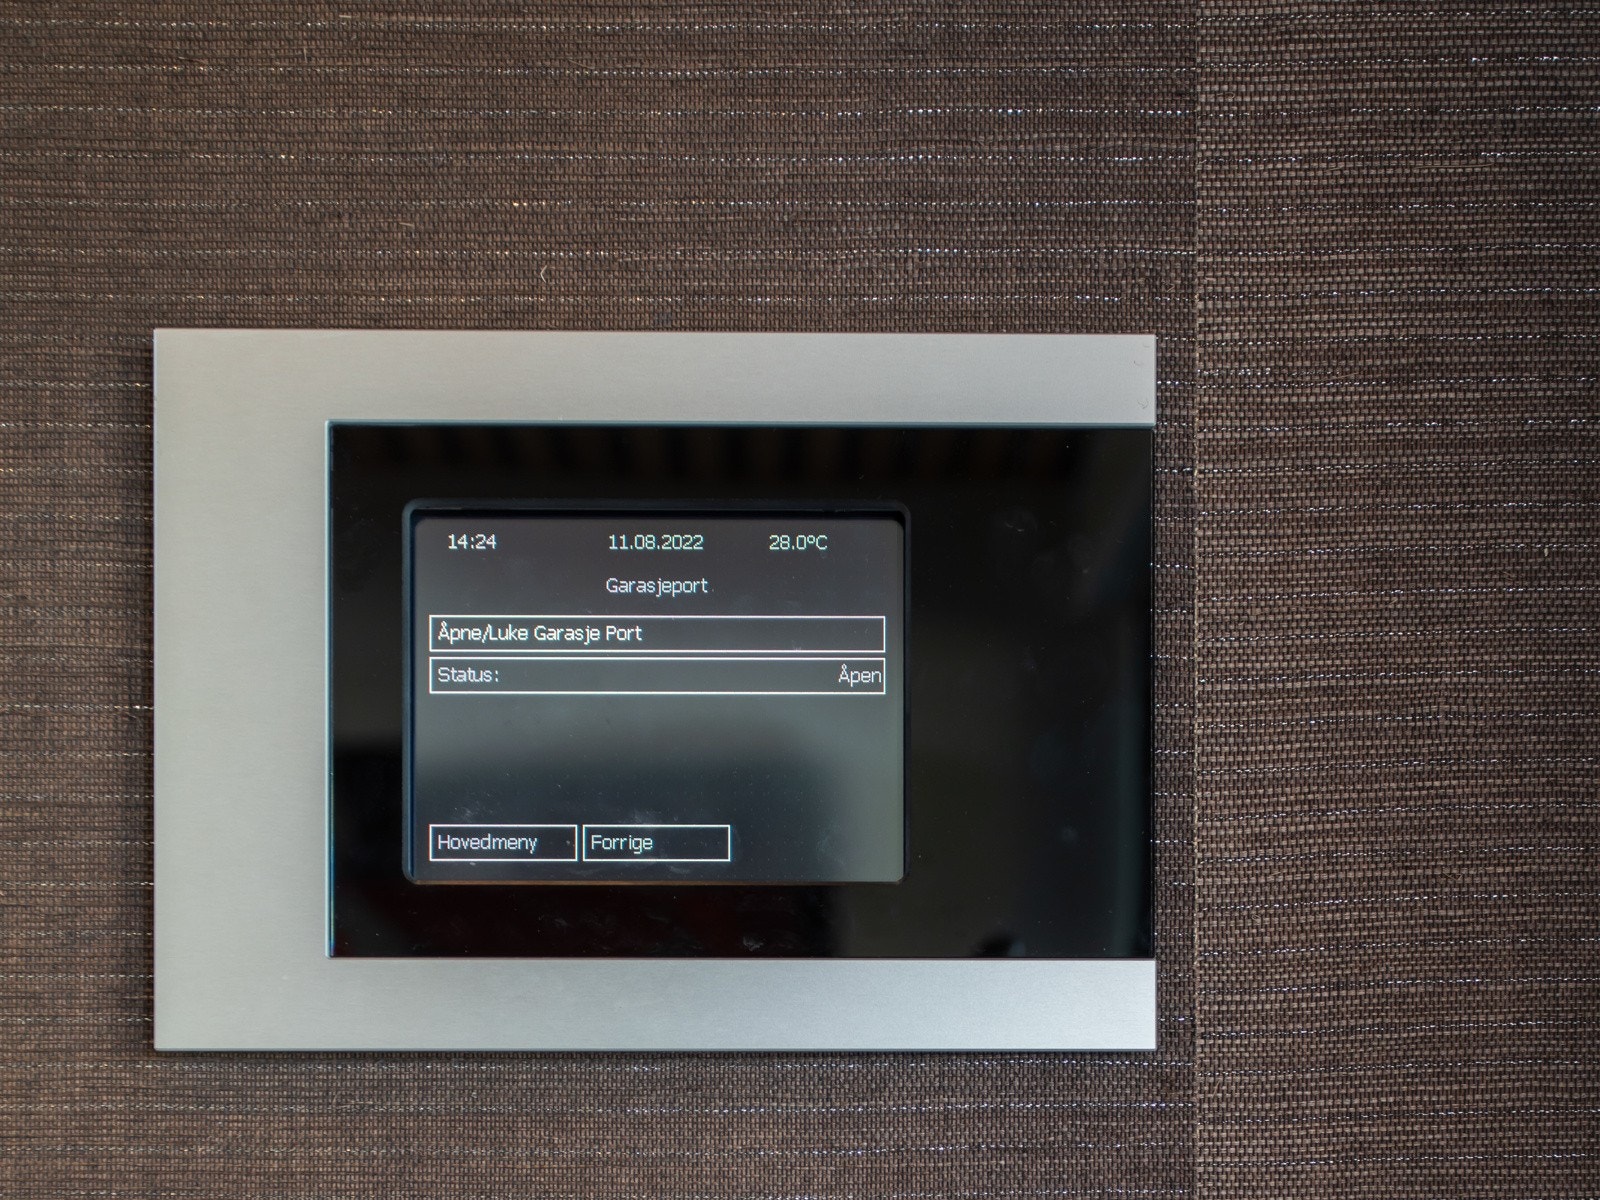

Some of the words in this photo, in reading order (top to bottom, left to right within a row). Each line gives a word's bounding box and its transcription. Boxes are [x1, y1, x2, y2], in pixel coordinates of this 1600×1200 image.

[448, 533, 497, 550] 14:24
[608, 533, 704, 550] 11.08.2022
[605, 577, 709, 598] Garasjeport
[437, 620, 529, 645] Åpne/Luke
[533, 625, 601, 646] Garasje
[605, 625, 643, 641] Port
[437, 666, 499, 683] Status:
[838, 663, 882, 688] Åpen
[437, 833, 538, 855] Hovedmeny
[591, 834, 654, 855] Forrige
